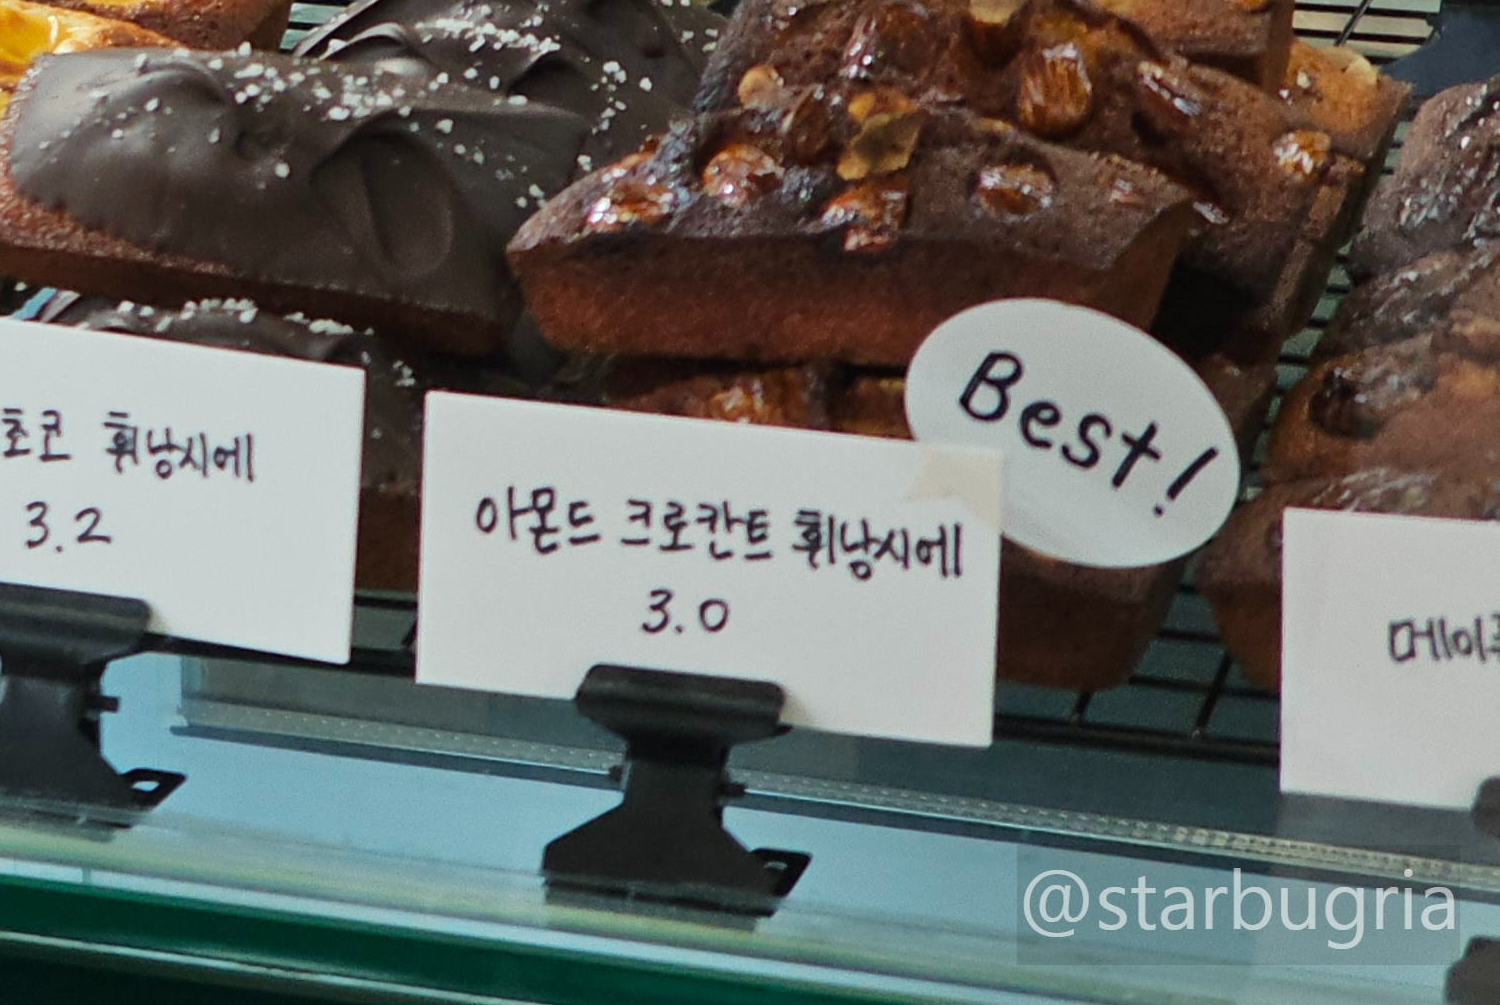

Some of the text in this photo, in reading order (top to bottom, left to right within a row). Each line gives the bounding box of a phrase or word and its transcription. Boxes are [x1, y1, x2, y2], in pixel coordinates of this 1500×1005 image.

[102, 410, 255, 483] 휘낭시에
[958, 351, 1219, 517] Best!
[24, 500, 113, 553] 3.2
[475, 485, 963, 583] 아몬드 크로칸트 휘낭시에
[639, 588, 730, 635] 3.0
